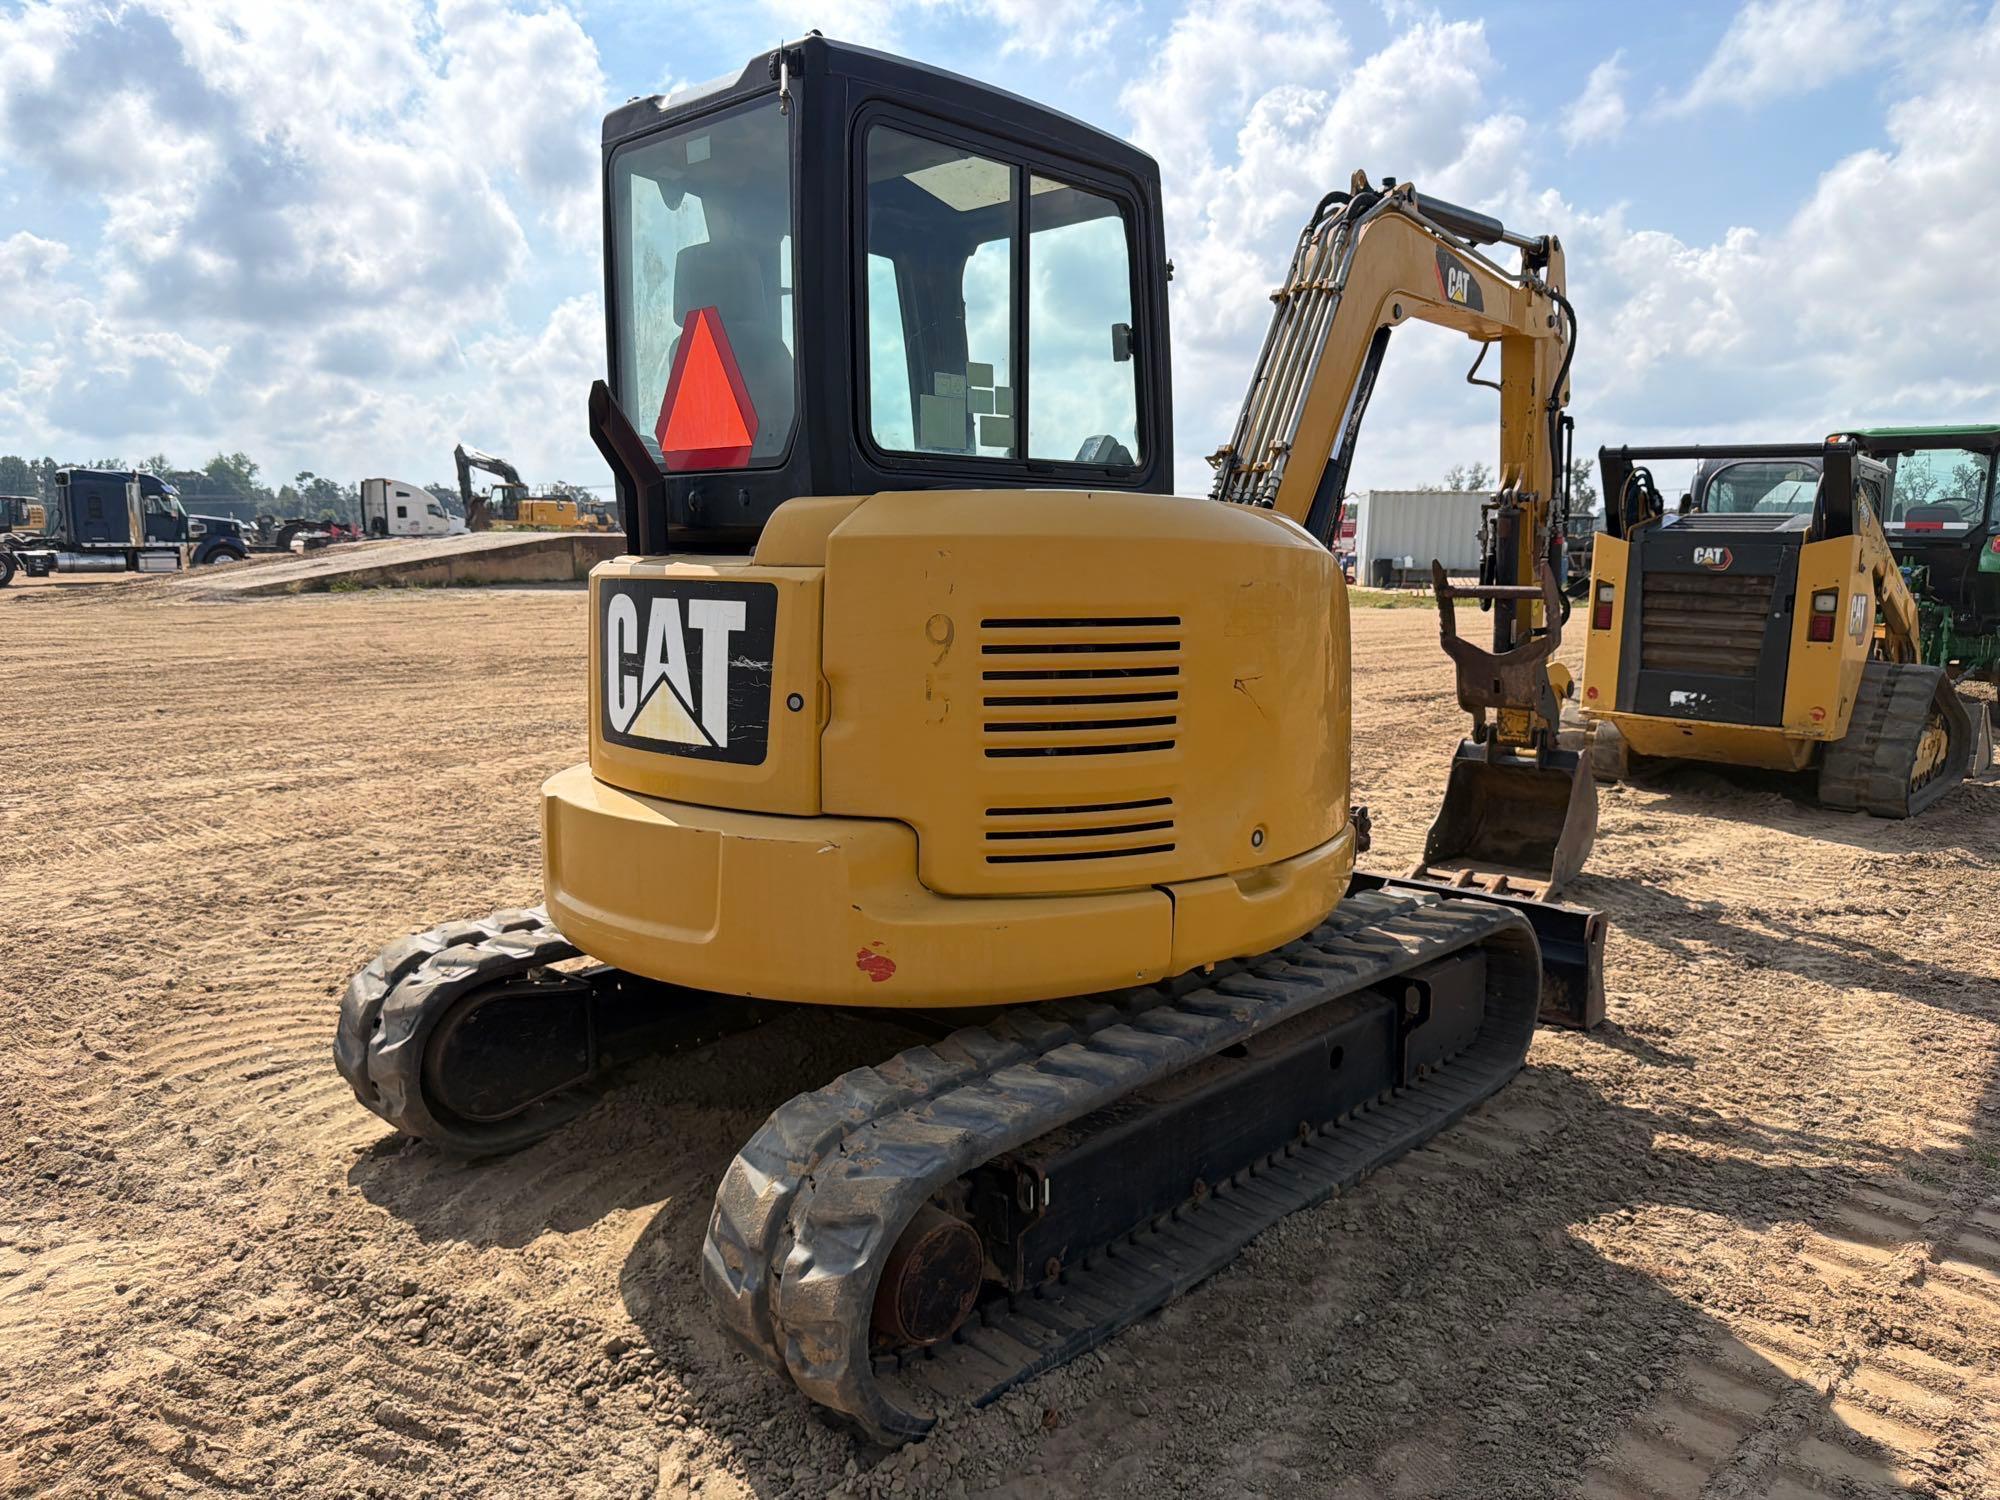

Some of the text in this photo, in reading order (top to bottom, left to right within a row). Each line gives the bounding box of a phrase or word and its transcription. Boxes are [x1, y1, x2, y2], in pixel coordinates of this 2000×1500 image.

[1447, 267, 1469, 304] CAT
[1694, 547, 1723, 564] CAT
[1850, 595, 1866, 634] CAT
[607, 593, 746, 748] CAT
